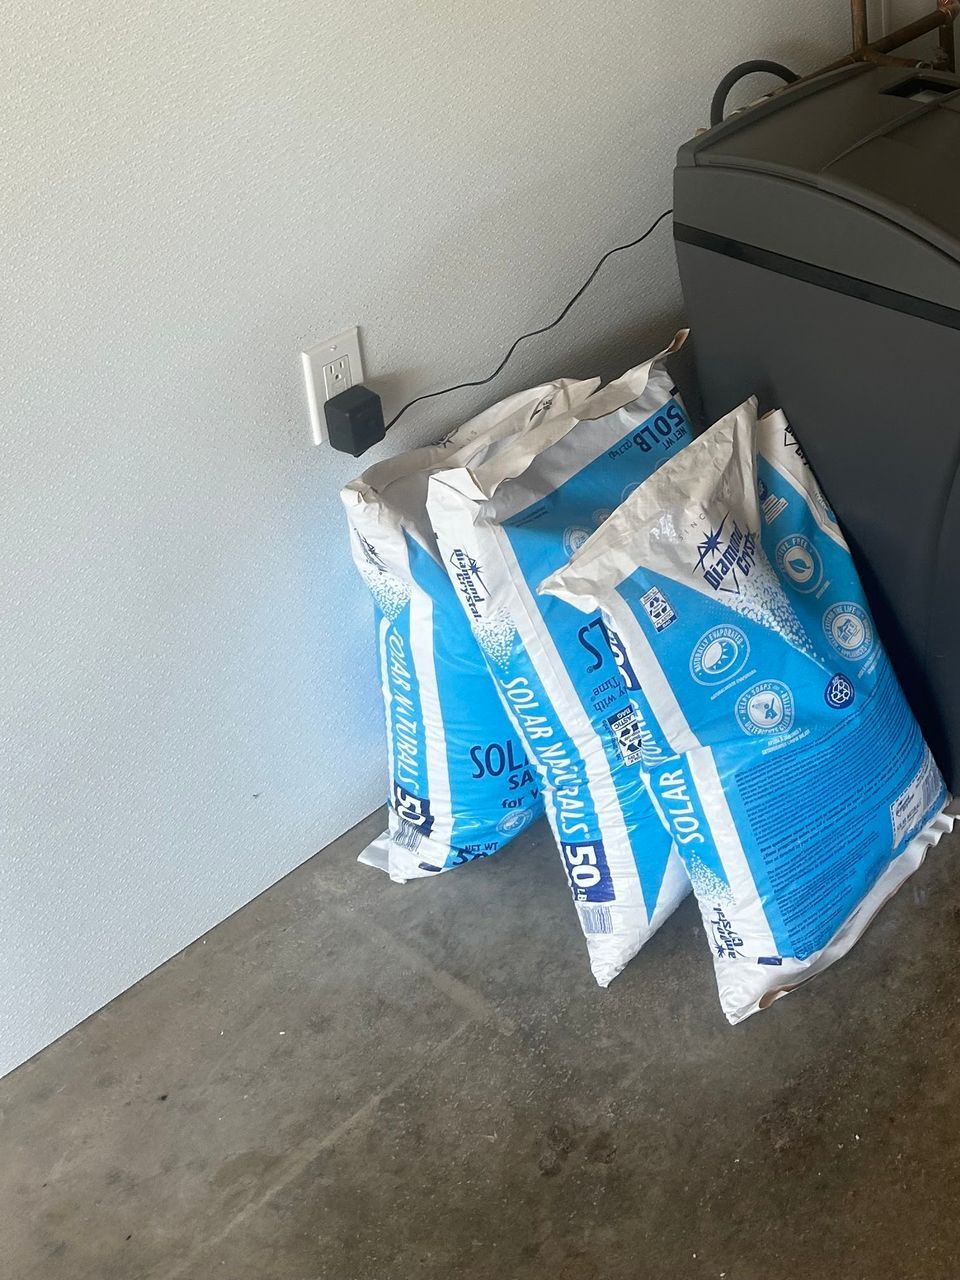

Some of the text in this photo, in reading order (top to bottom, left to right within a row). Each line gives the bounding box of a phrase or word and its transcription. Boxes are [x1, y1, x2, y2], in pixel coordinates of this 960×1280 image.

[662, 426, 688, 451] NET WT
[453, 548, 485, 602] Diamond
[593, 676, 621, 695] Time
[593, 692, 617, 712] with
[470, 739, 530, 779] SOL
[500, 676, 588, 839] SOLAR NATURALS
[508, 770, 535, 790] SA
[397, 786, 426, 826] 50
[502, 795, 525, 809] for
[658, 769, 704, 845] SOLAR
[484, 841, 499, 851] WT
[565, 845, 600, 889] 50
